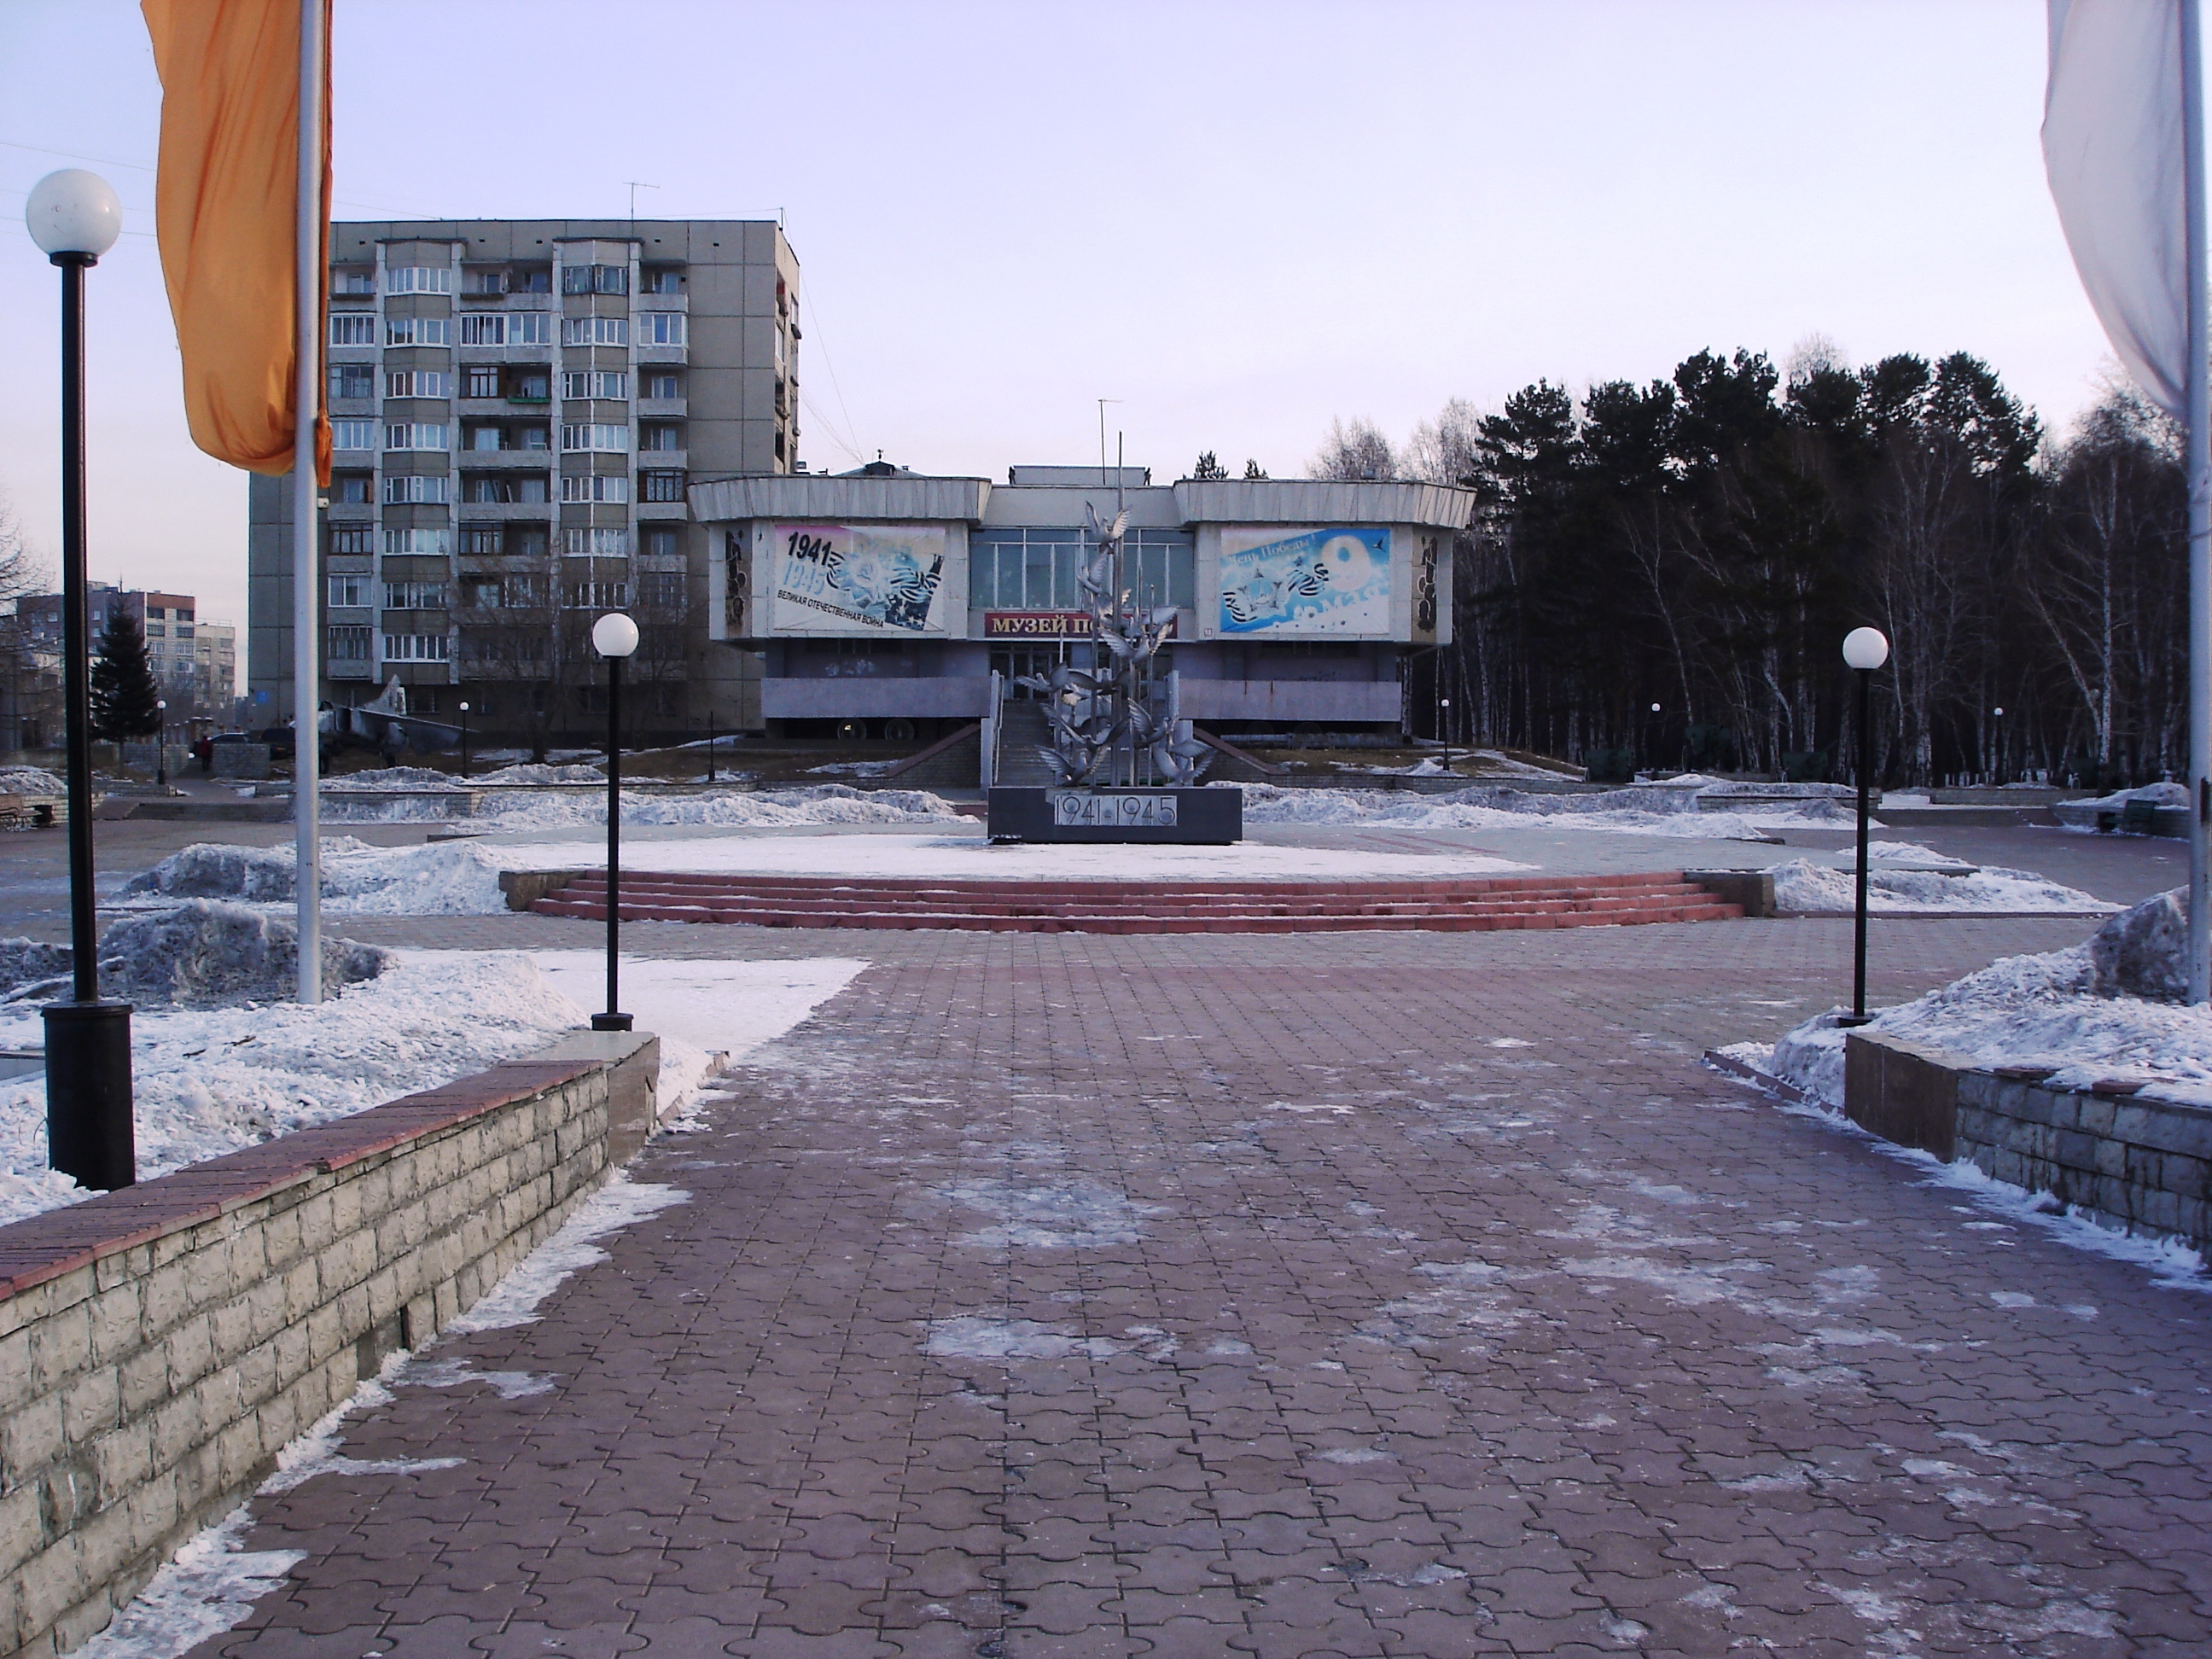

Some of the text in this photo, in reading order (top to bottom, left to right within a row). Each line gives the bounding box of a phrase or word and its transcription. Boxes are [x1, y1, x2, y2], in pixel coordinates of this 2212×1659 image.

[788, 531, 832, 567] 1941
[783, 560, 827, 596] 1945
[777, 589, 884, 629] ВЕЛИКАЯ ОТЕЧЕСТВЕННАЯ ВОЙНА
[992, 614, 1068, 633] МУЗЕЙ
[1056, 795, 1176, 825] 1941-1945
